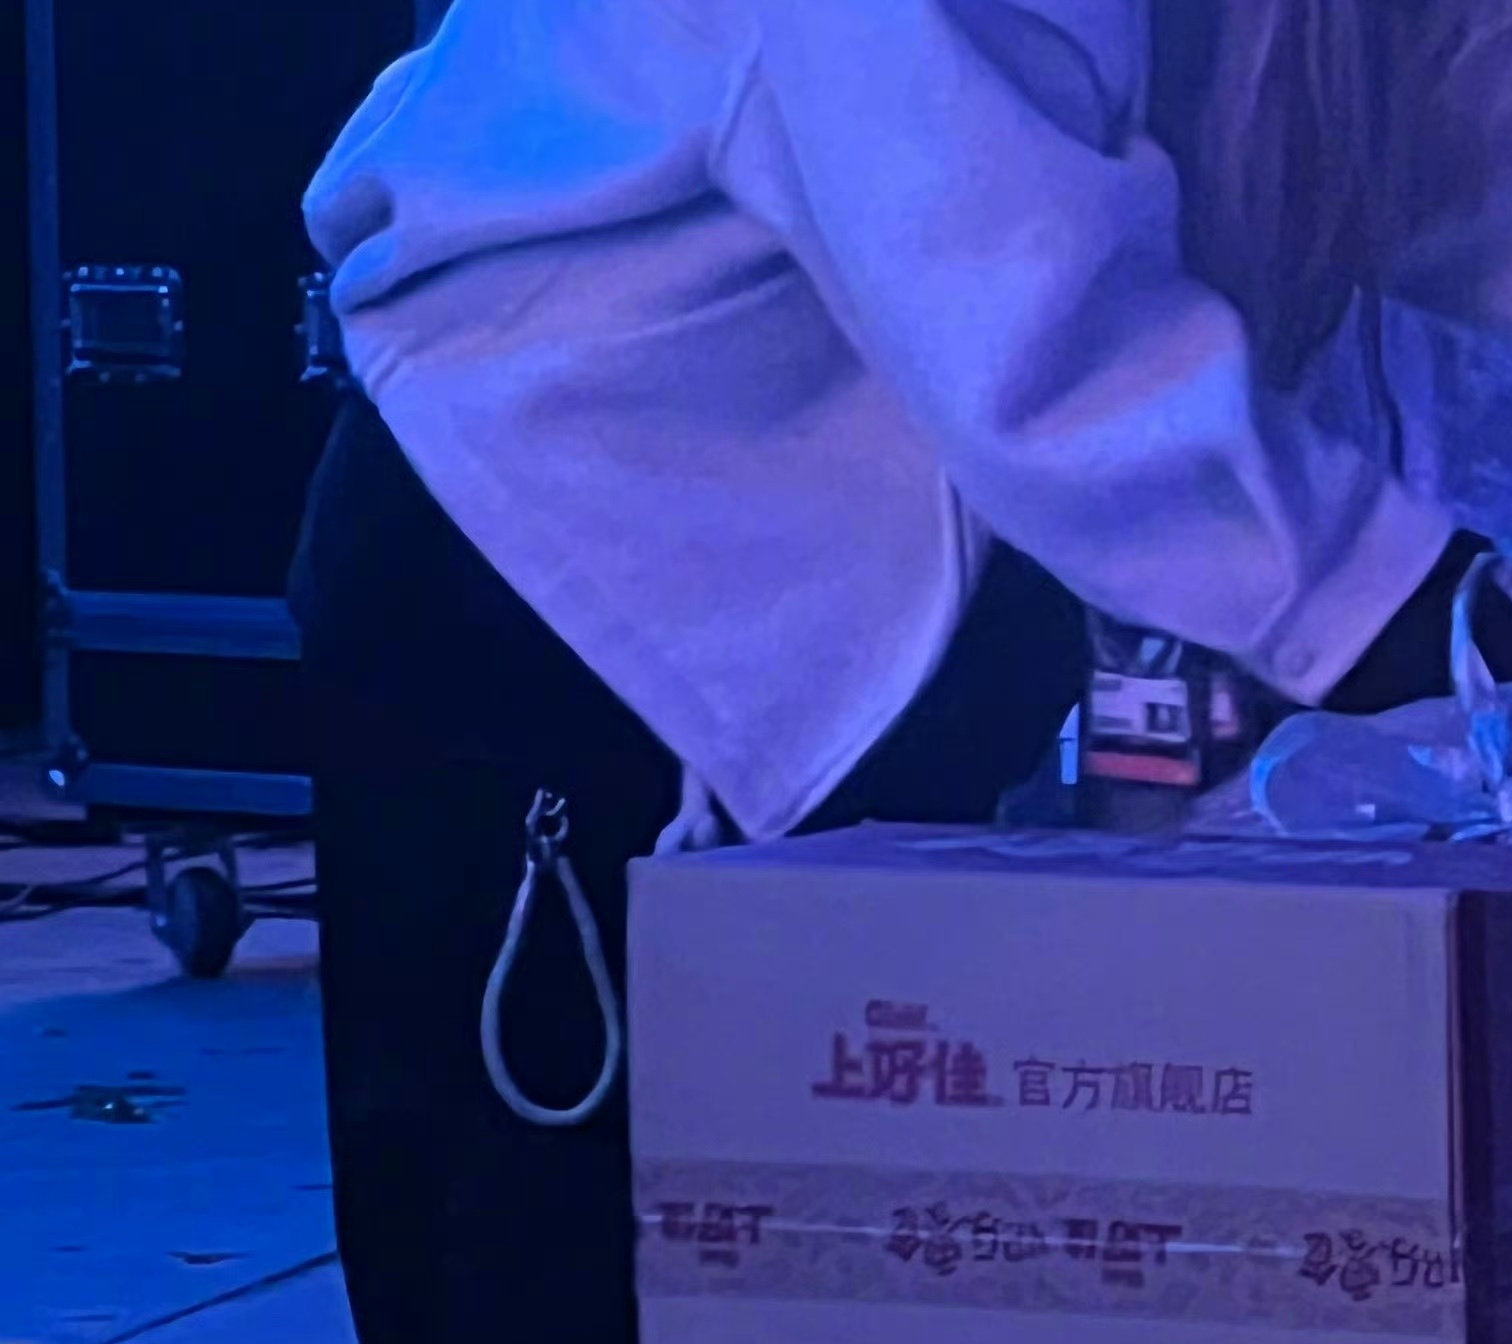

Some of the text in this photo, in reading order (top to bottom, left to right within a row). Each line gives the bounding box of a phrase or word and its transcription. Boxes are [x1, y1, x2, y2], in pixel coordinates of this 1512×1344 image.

[1012, 1057, 1255, 1116] 官方旗舰店
